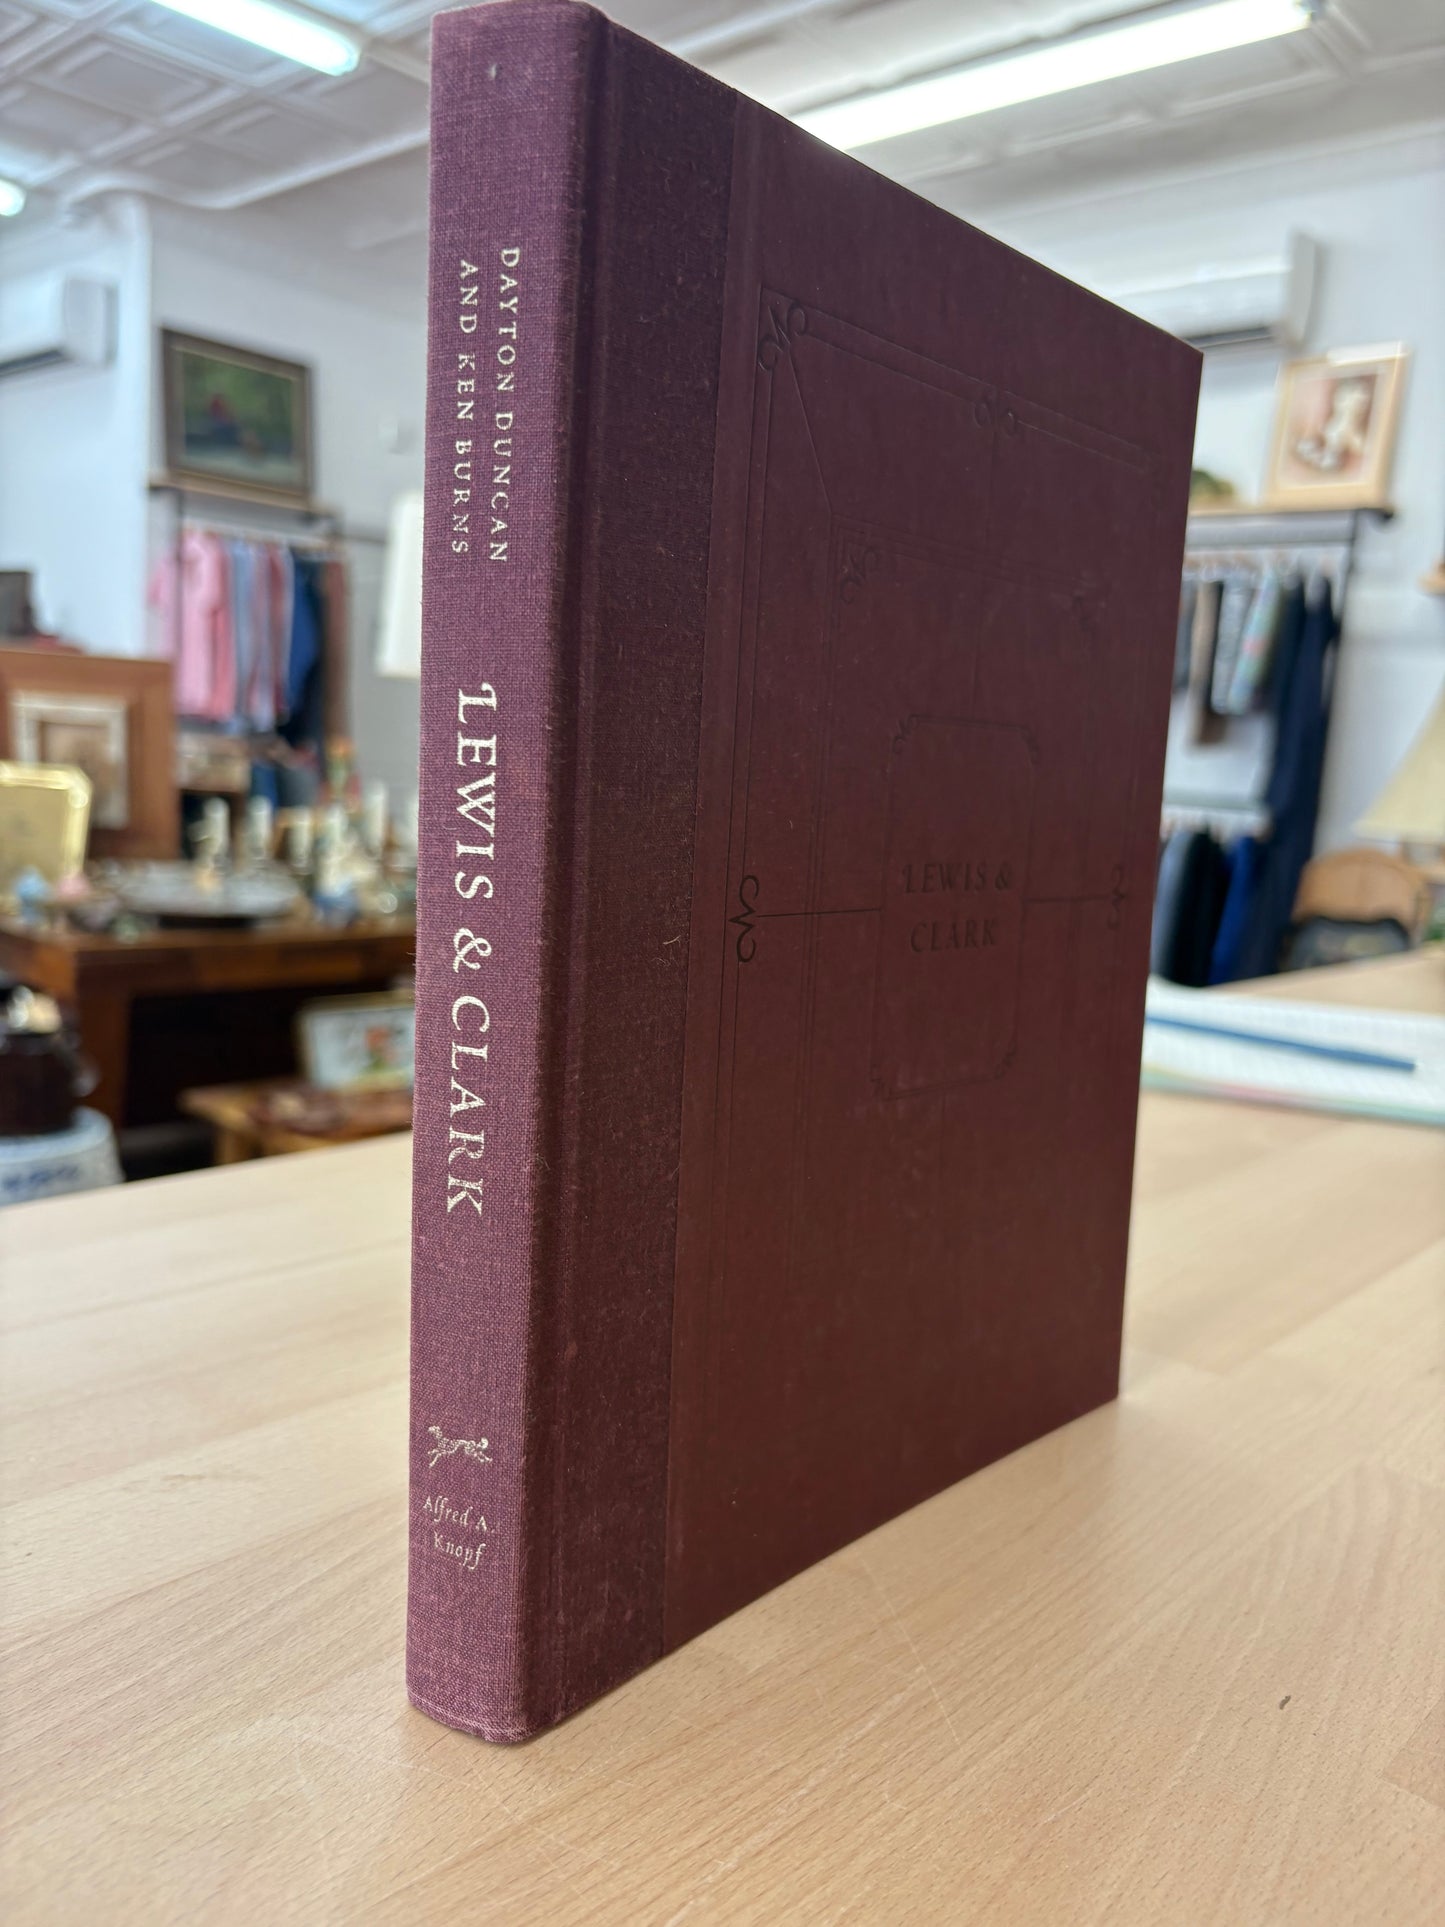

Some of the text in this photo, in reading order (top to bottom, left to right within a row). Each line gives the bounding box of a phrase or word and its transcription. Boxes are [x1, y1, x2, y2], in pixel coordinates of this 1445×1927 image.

[451, 260, 479, 554] AND KEN BURNS
[489, 246, 521, 562] DAYTON DUNCAN
[902, 860, 1013, 894] LEWIS &
[447, 682, 498, 1216] LEWIS & CLARK
[910, 918, 1000, 953] CLARK
[423, 1495, 473, 1528] Alfred
[433, 1531, 487, 1570] Knopf
